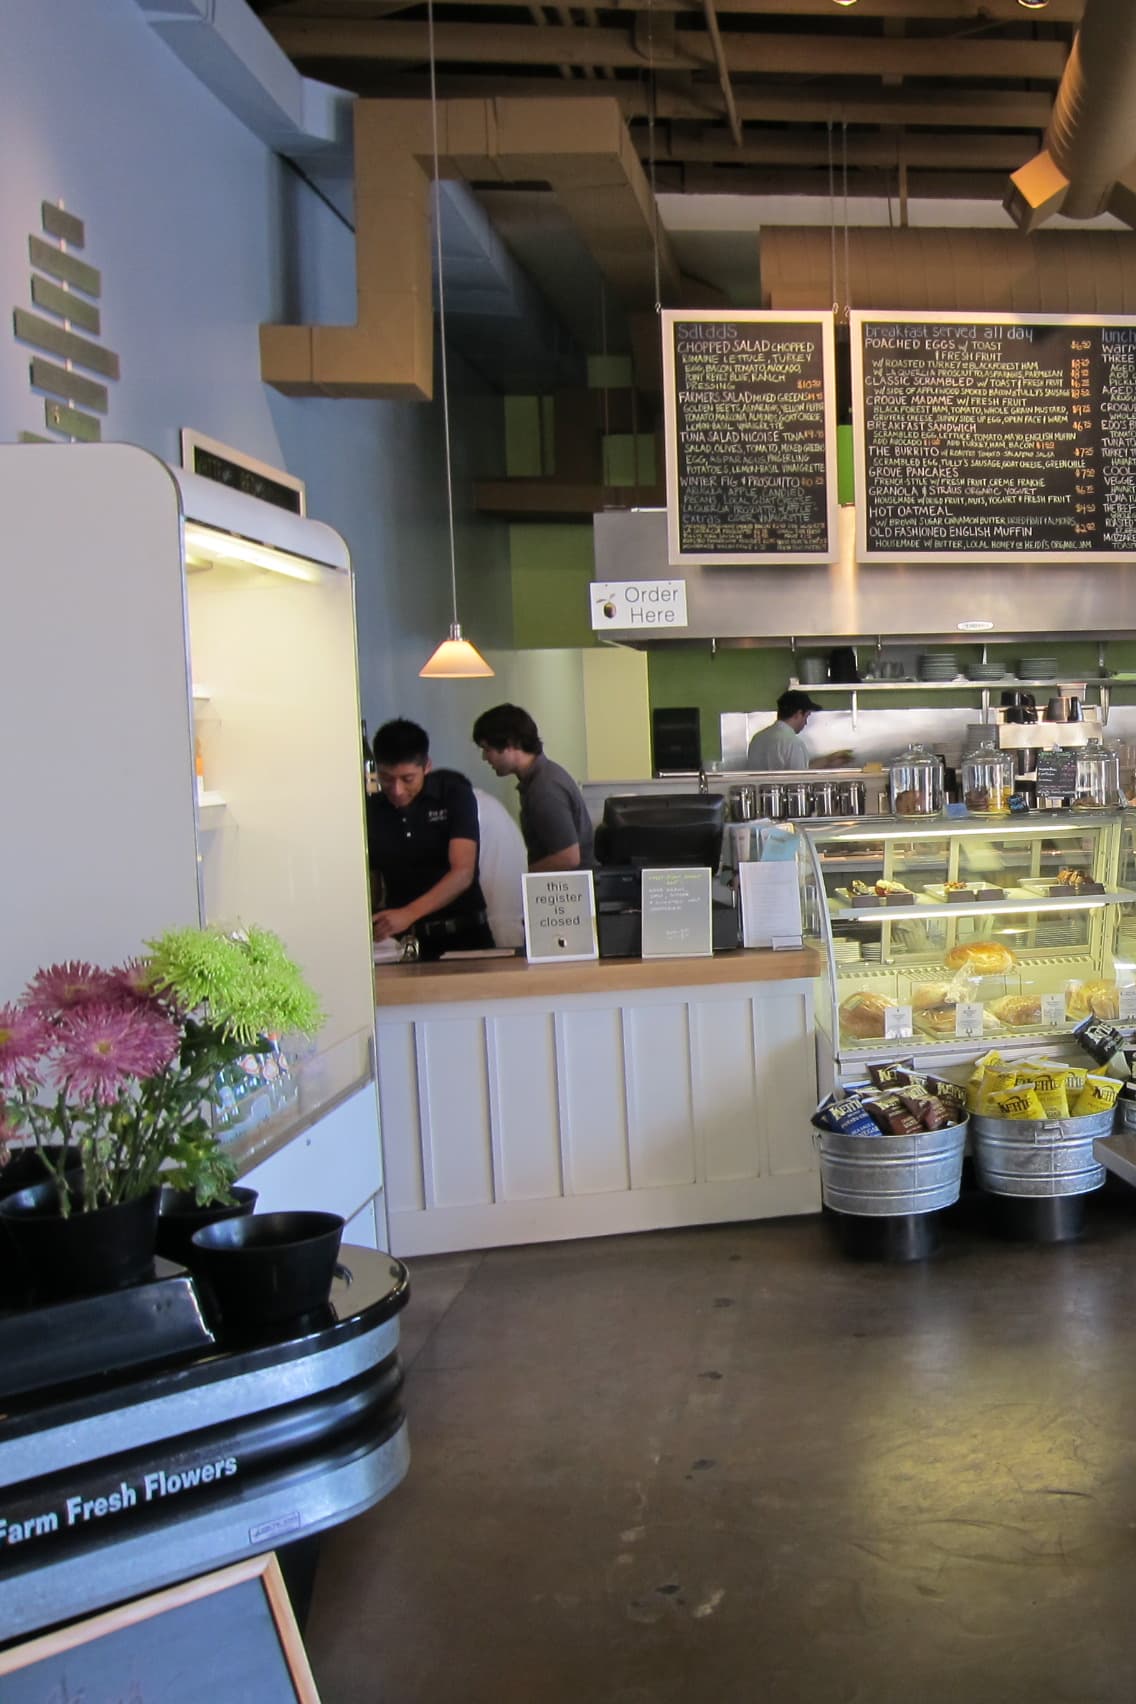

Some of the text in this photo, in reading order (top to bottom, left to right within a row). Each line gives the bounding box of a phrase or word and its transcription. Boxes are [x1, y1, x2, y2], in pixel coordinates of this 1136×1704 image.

[866, 324, 1033, 342] breakfast served all day
[1102, 328, 1136, 343] lunch
[678, 340, 814, 353] CHOPPED SALAD CHOPPED
[865, 338, 1002, 350] POACHED EGGS TOAST
[774, 354, 812, 364] TURKEY
[942, 351, 1002, 361] FRESH FRUIT
[1102, 354, 1134, 364] THREE
[886, 360, 1039, 370] ROASTED TURKEY HAM
[865, 376, 1016, 387] CLASSIC SCRAMBLED TOAST
[1102, 385, 1133, 394] AGED
[678, 391, 750, 403] FARMERS SALAD
[866, 396, 1027, 406] CROQUE MADAME FRESH FRUIT
[866, 421, 976, 432] BREAKFAST SANDWICH
[680, 432, 704, 442] TUNA
[708, 432, 740, 442] SALAD
[1102, 438, 1124, 447] TUNA
[868, 446, 939, 456] THE BURRITO
[874, 458, 920, 466] SCRAMBLED
[868, 466, 959, 478] GROVE PANCAKES
[1103, 466, 1136, 476] COOL
[680, 476, 738, 486] WINTER FIG
[1104, 476, 1135, 486] VEGGIE
[869, 486, 918, 496] GRANOLA
[929, 486, 962, 494] STRAUS
[1004, 488, 1037, 496] YOGURT
[1048, 494, 1072, 503] FRUIT
[1105, 494, 1128, 504] TUNA
[870, 506, 953, 518] HOT OATMEAL
[870, 526, 1032, 537] OLD FASHIONED ENGLISH MUFFIN
[624, 586, 678, 602] Order
[630, 607, 674, 623] Here
[547, 881, 568, 891] this
[536, 894, 582, 906] register
[555, 906, 564, 914] is
[540, 916, 580, 927] closed
[0, 1456, 238, 1545] Farm Fresh Flowers
